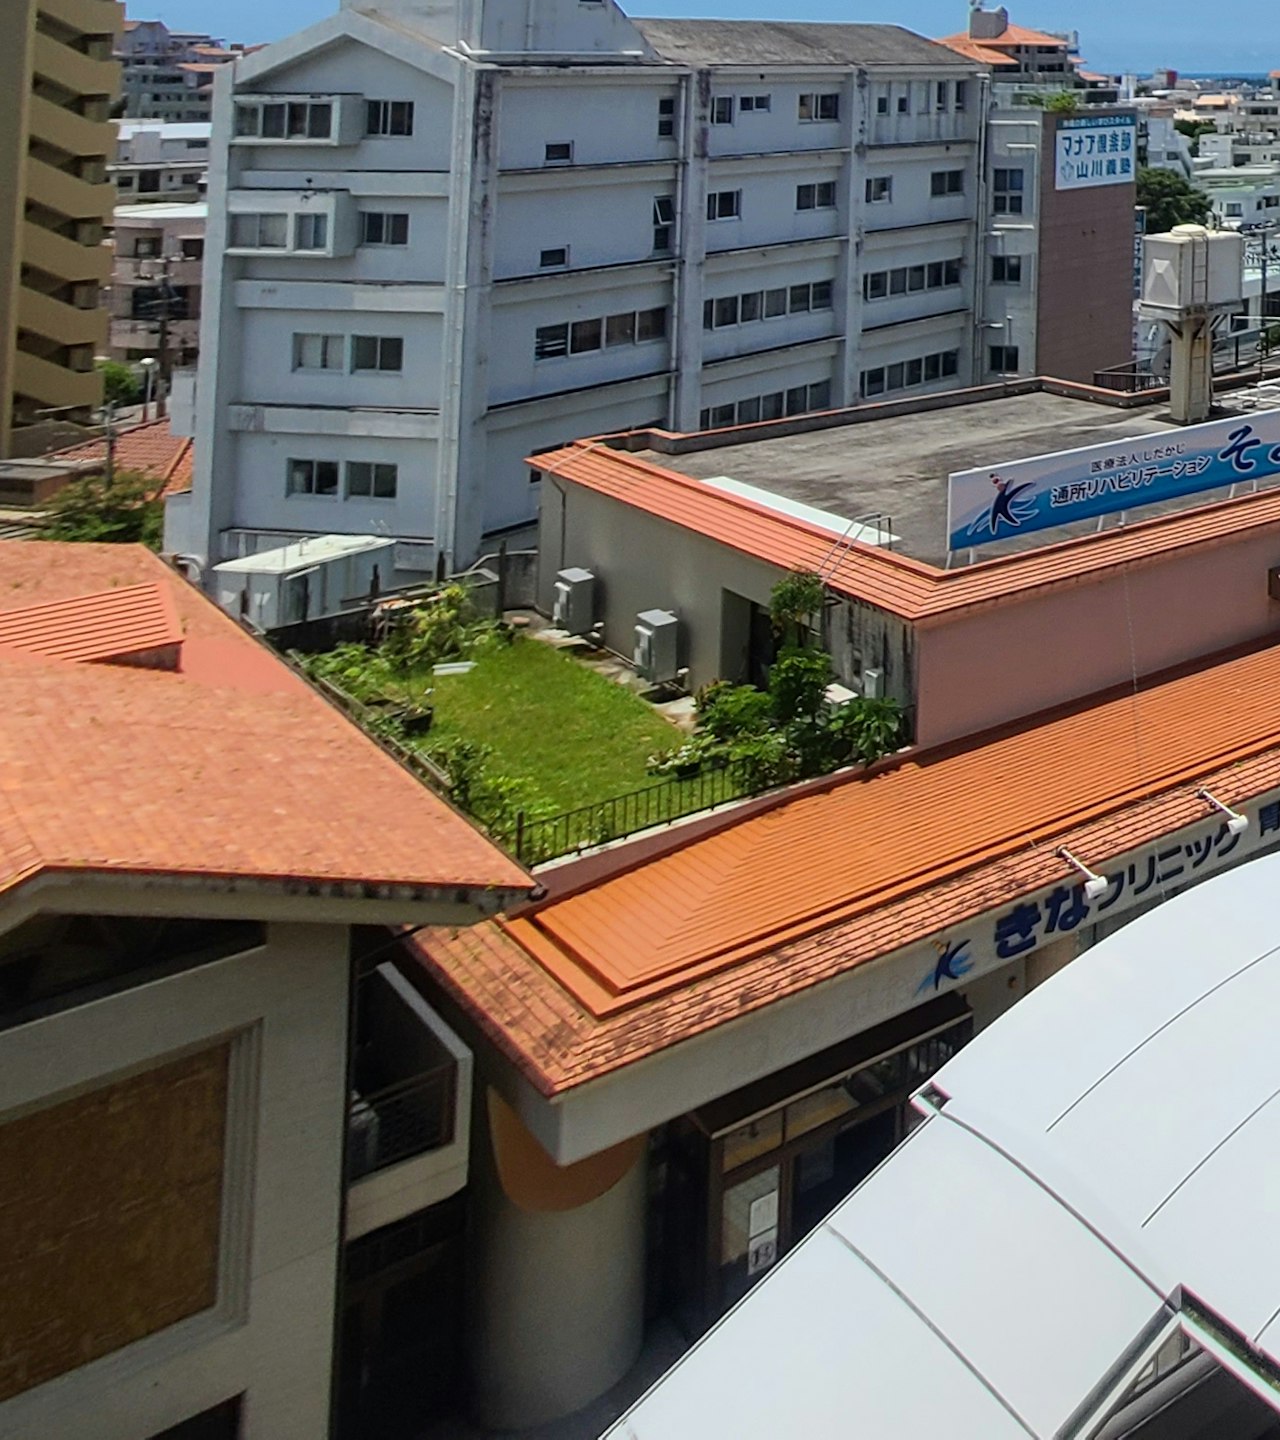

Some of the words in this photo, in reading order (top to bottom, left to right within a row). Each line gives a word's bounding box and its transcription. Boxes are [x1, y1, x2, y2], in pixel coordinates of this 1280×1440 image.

[1050, 455, 1212, 507] 通所リハビリテーション
